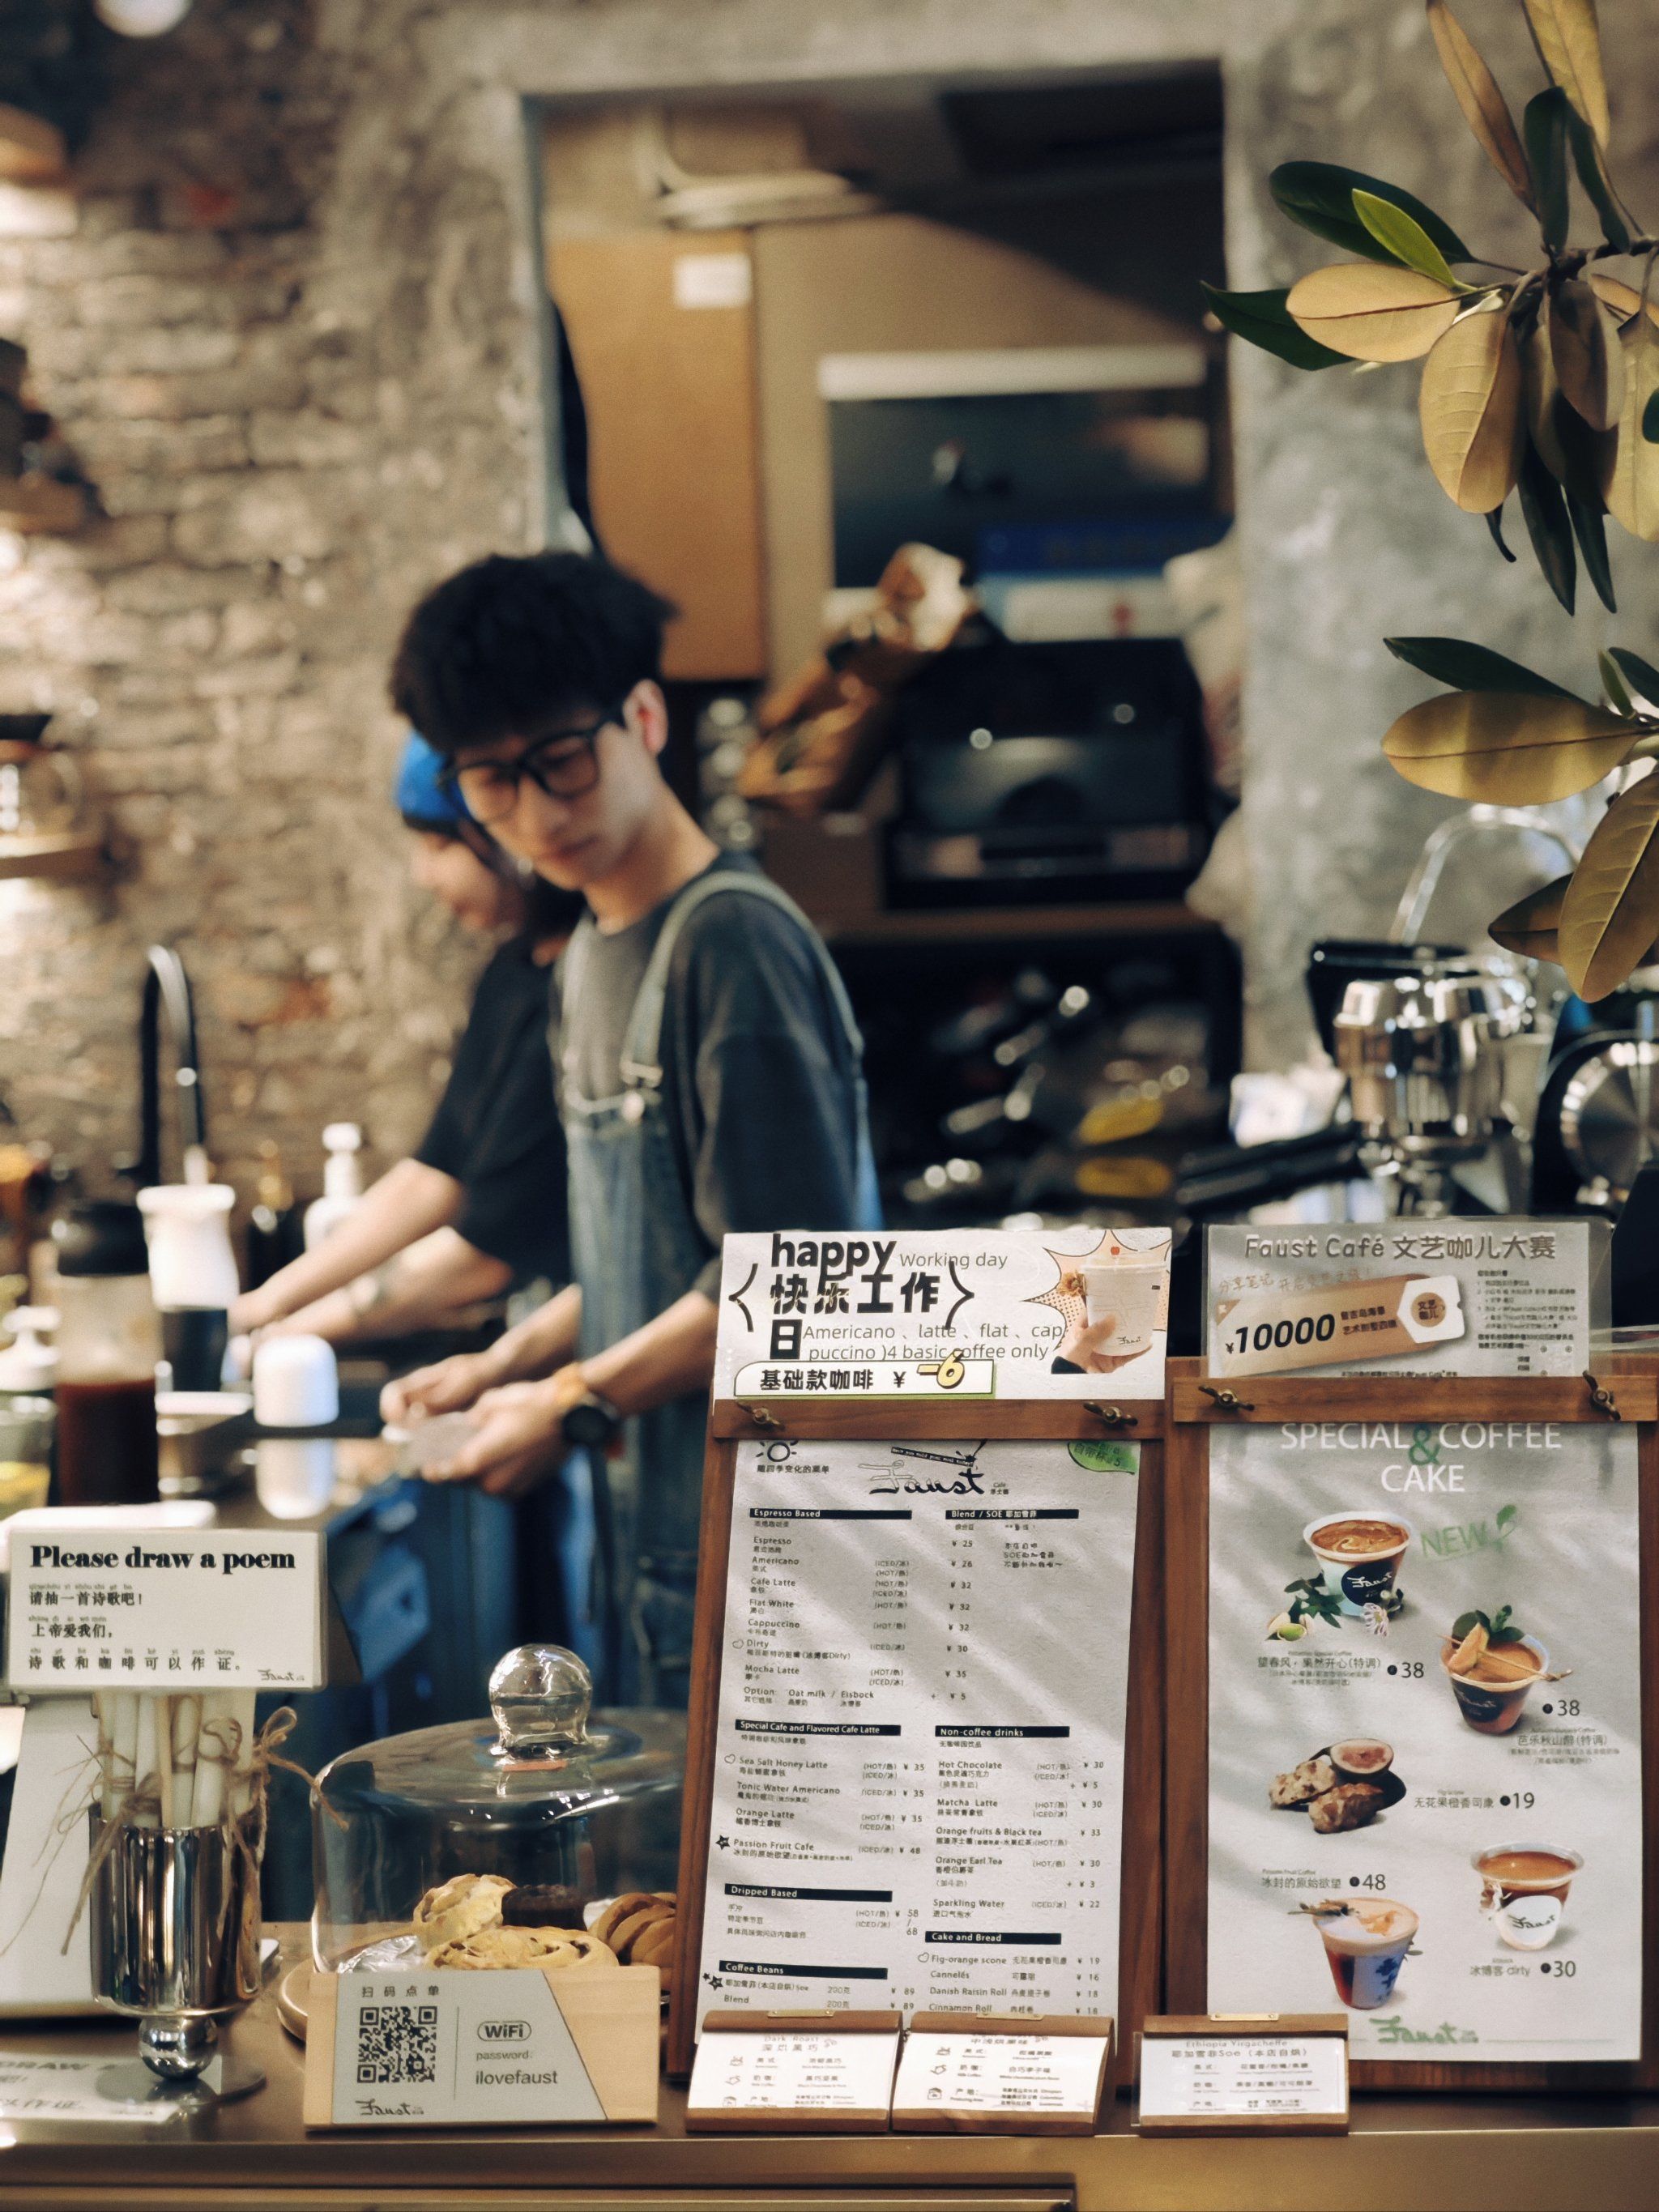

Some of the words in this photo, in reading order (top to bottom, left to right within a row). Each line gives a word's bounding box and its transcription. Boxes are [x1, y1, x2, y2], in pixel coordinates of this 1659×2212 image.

[1244, 1234, 1318, 1258] Faust
[1325, 1234, 1385, 1258] Café
[1392, 1232, 1556, 1259] 文艺咖儿大赛
[771, 1234, 897, 1276] happy
[901, 1252, 970, 1269] Working
[976, 1252, 1008, 1269] day
[804, 1326, 895, 1340] Americano
[919, 1324, 957, 1338] latte
[980, 1323, 1008, 1337] flat
[1032, 1326, 1063, 1341] cap
[809, 1347, 875, 1361] puccino
[903, 1345, 946, 1359] basic
[1012, 1344, 1048, 1359] only
[761, 1369, 874, 1391] 基础款咖啡
[1281, 1422, 1410, 1449] SPECIAL
[1409, 1423, 1441, 1466] &
[1439, 1422, 1563, 1449] COFFEE
[858, 1460, 985, 1494] Faust
[1381, 1464, 1465, 1493] CAKE
[754, 1509, 792, 1518] Espresso
[795, 1510, 821, 1518] Based
[753, 1537, 791, 1545] Espresso
[30, 1545, 118, 1568] Please
[125, 1546, 194, 1568] draw
[200, 1553, 216, 1568] a
[223, 1552, 296, 1575] poem
[752, 1557, 800, 1565] Americano
[751, 1578, 770, 1586] Cafe
[774, 1579, 796, 1587] Latte
[769, 1600, 795, 1609] White
[748, 1619, 800, 1629] Cappuccino
[747, 1639, 770, 1648] Dirty
[744, 1664, 774, 1673] Mocha
[777, 1666, 800, 1674] Latte
[1401, 1662, 1424, 1678] 38
[789, 1689, 804, 1697] Oat
[1558, 1699, 1580, 1716] 38
[740, 1721, 769, 1731] Special
[770, 1723, 787, 1731] Cafe
[789, 1724, 804, 1732] and
[806, 1725, 839, 1733] Flavored
[841, 1725, 859, 1733] Cafe
[940, 1728, 992, 1737] Non-coffee
[995, 1728, 1023, 1737] drinks
[740, 1756, 754, 1764] Sea
[757, 1758, 774, 1766] Salt
[776, 1758, 804, 1770] Honey
[806, 1761, 828, 1769] Latte
[915, 1763, 924, 1771] 35
[957, 1761, 1002, 1770] Chocolate
[737, 1782, 766, 1791] Tonic
[768, 1784, 790, 1792] Water
[792, 1785, 840, 1794] Americano
[937, 1799, 970, 1807] Matcha
[1092, 1801, 1102, 1809] 30
[1513, 1792, 1534, 1809] 19
[736, 1808, 769, 1818] Orange
[771, 1810, 795, 1819] Latte
[936, 1827, 967, 1837] Orange
[734, 1839, 767, 1848] Passion
[770, 1841, 791, 1850] Fruit
[794, 1843, 814, 1851] Cafe
[936, 1856, 967, 1867] Orange
[970, 1857, 987, 1865] Earl
[1363, 1873, 1386, 1890] 48
[731, 1886, 768, 1897] Dripped
[771, 1889, 797, 1898] Based
[932, 1899, 976, 1909] Sparkling
[979, 1899, 1004, 1908] Water
[907, 1909, 919, 1917] 58
[906, 1928, 918, 1936] 68
[932, 1933, 953, 1941] Cake
[932, 1955, 979, 1966] Fig-orange
[982, 1957, 1007, 1965] scone
[1090, 1957, 1100, 1965] 19
[725, 1963, 754, 1972] Coffee
[757, 1965, 783, 1975] Beans
[1554, 1960, 1576, 1978] 30
[931, 1971, 970, 1980] Cannelés
[361, 1984, 440, 1997] 扫码点单
[930, 1987, 959, 1995] Danish
[962, 1988, 987, 1997] Raisin
[990, 1988, 1007, 1997] Roll
[724, 1995, 749, 2004] Blend
[903, 2002, 914, 2010] 89
[929, 2003, 972, 2012] Cinnamon
[975, 2005, 992, 2013] Roll
[485, 2023, 524, 2038] WiFi
[476, 2070, 558, 2085] ilovefaust
